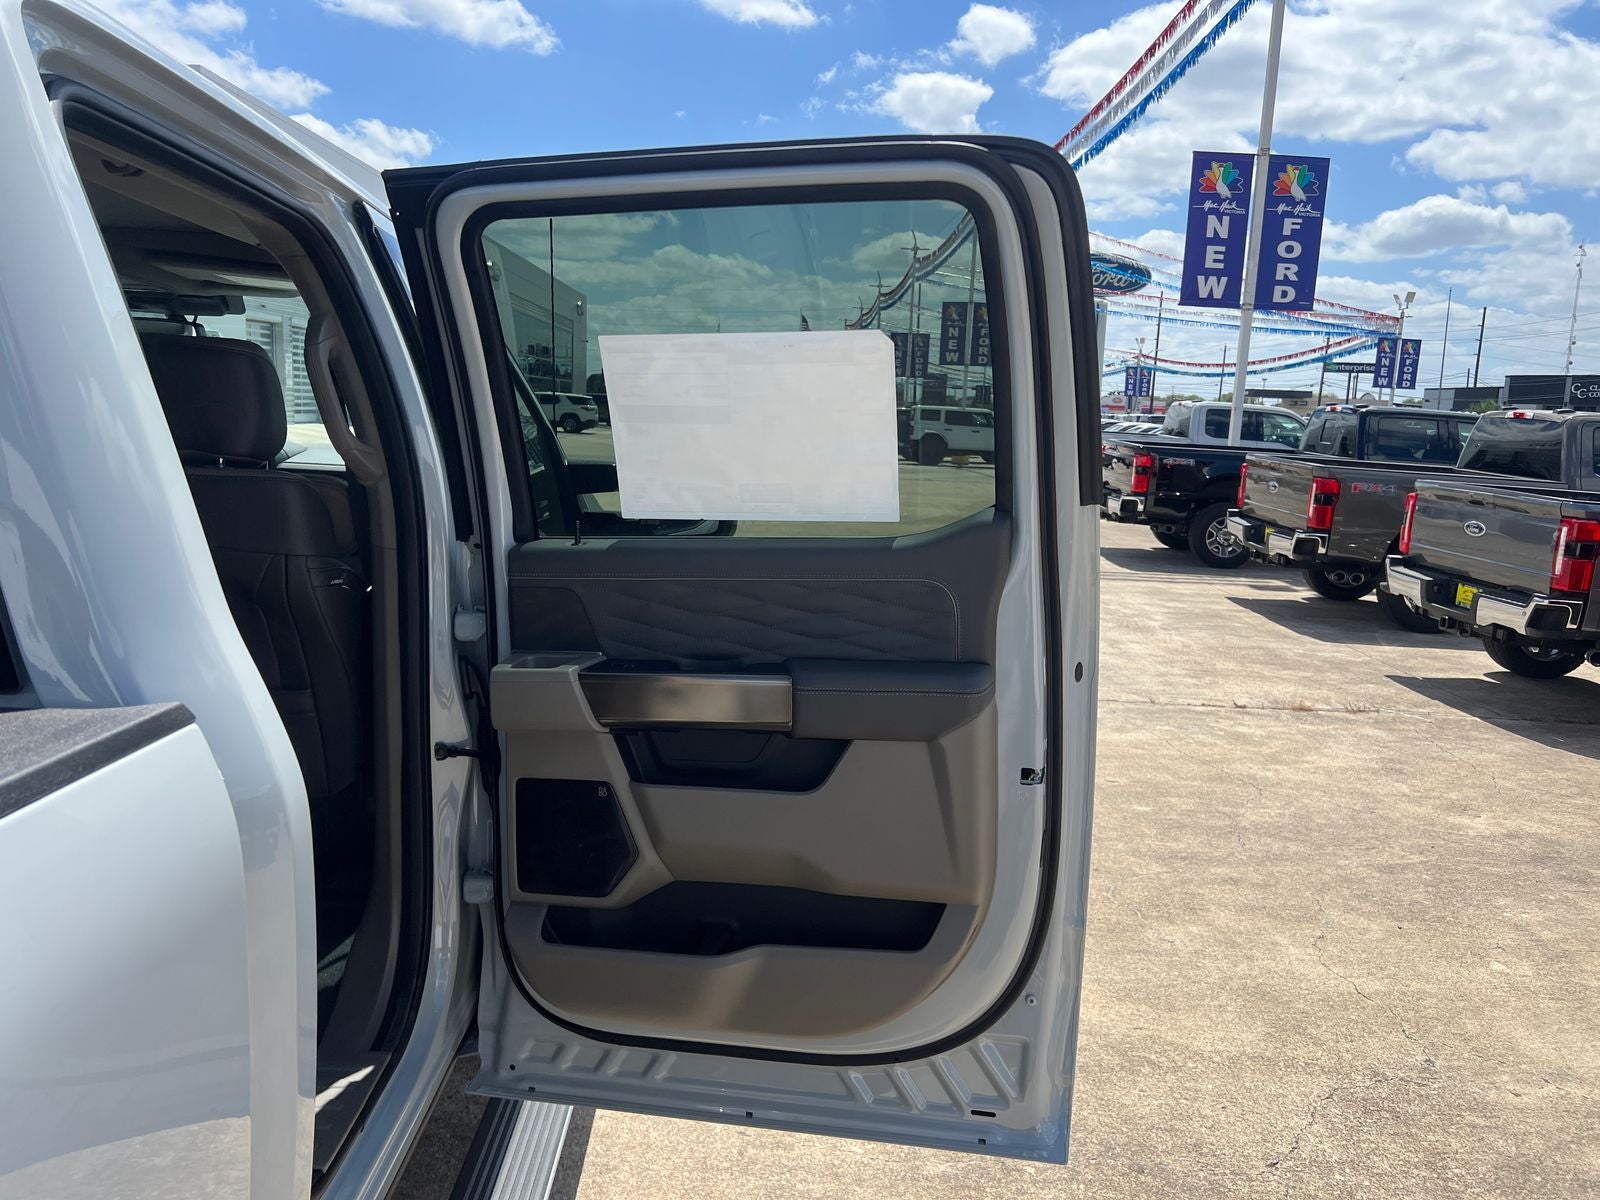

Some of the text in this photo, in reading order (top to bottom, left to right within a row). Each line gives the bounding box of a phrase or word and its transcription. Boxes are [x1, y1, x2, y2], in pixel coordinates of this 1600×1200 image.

[1197, 215, 1230, 299] NEW
[1272, 217, 1303, 303] FORD
[945, 326, 959, 362] NEW
[978, 328, 990, 364] FORD
[915, 350, 924, 377] FORD
[1377, 357, 1390, 386] NEW
[1401, 359, 1413, 388] FORD
[1126, 378, 1134, 396] NEW
[1351, 482, 1396, 495] FX4
